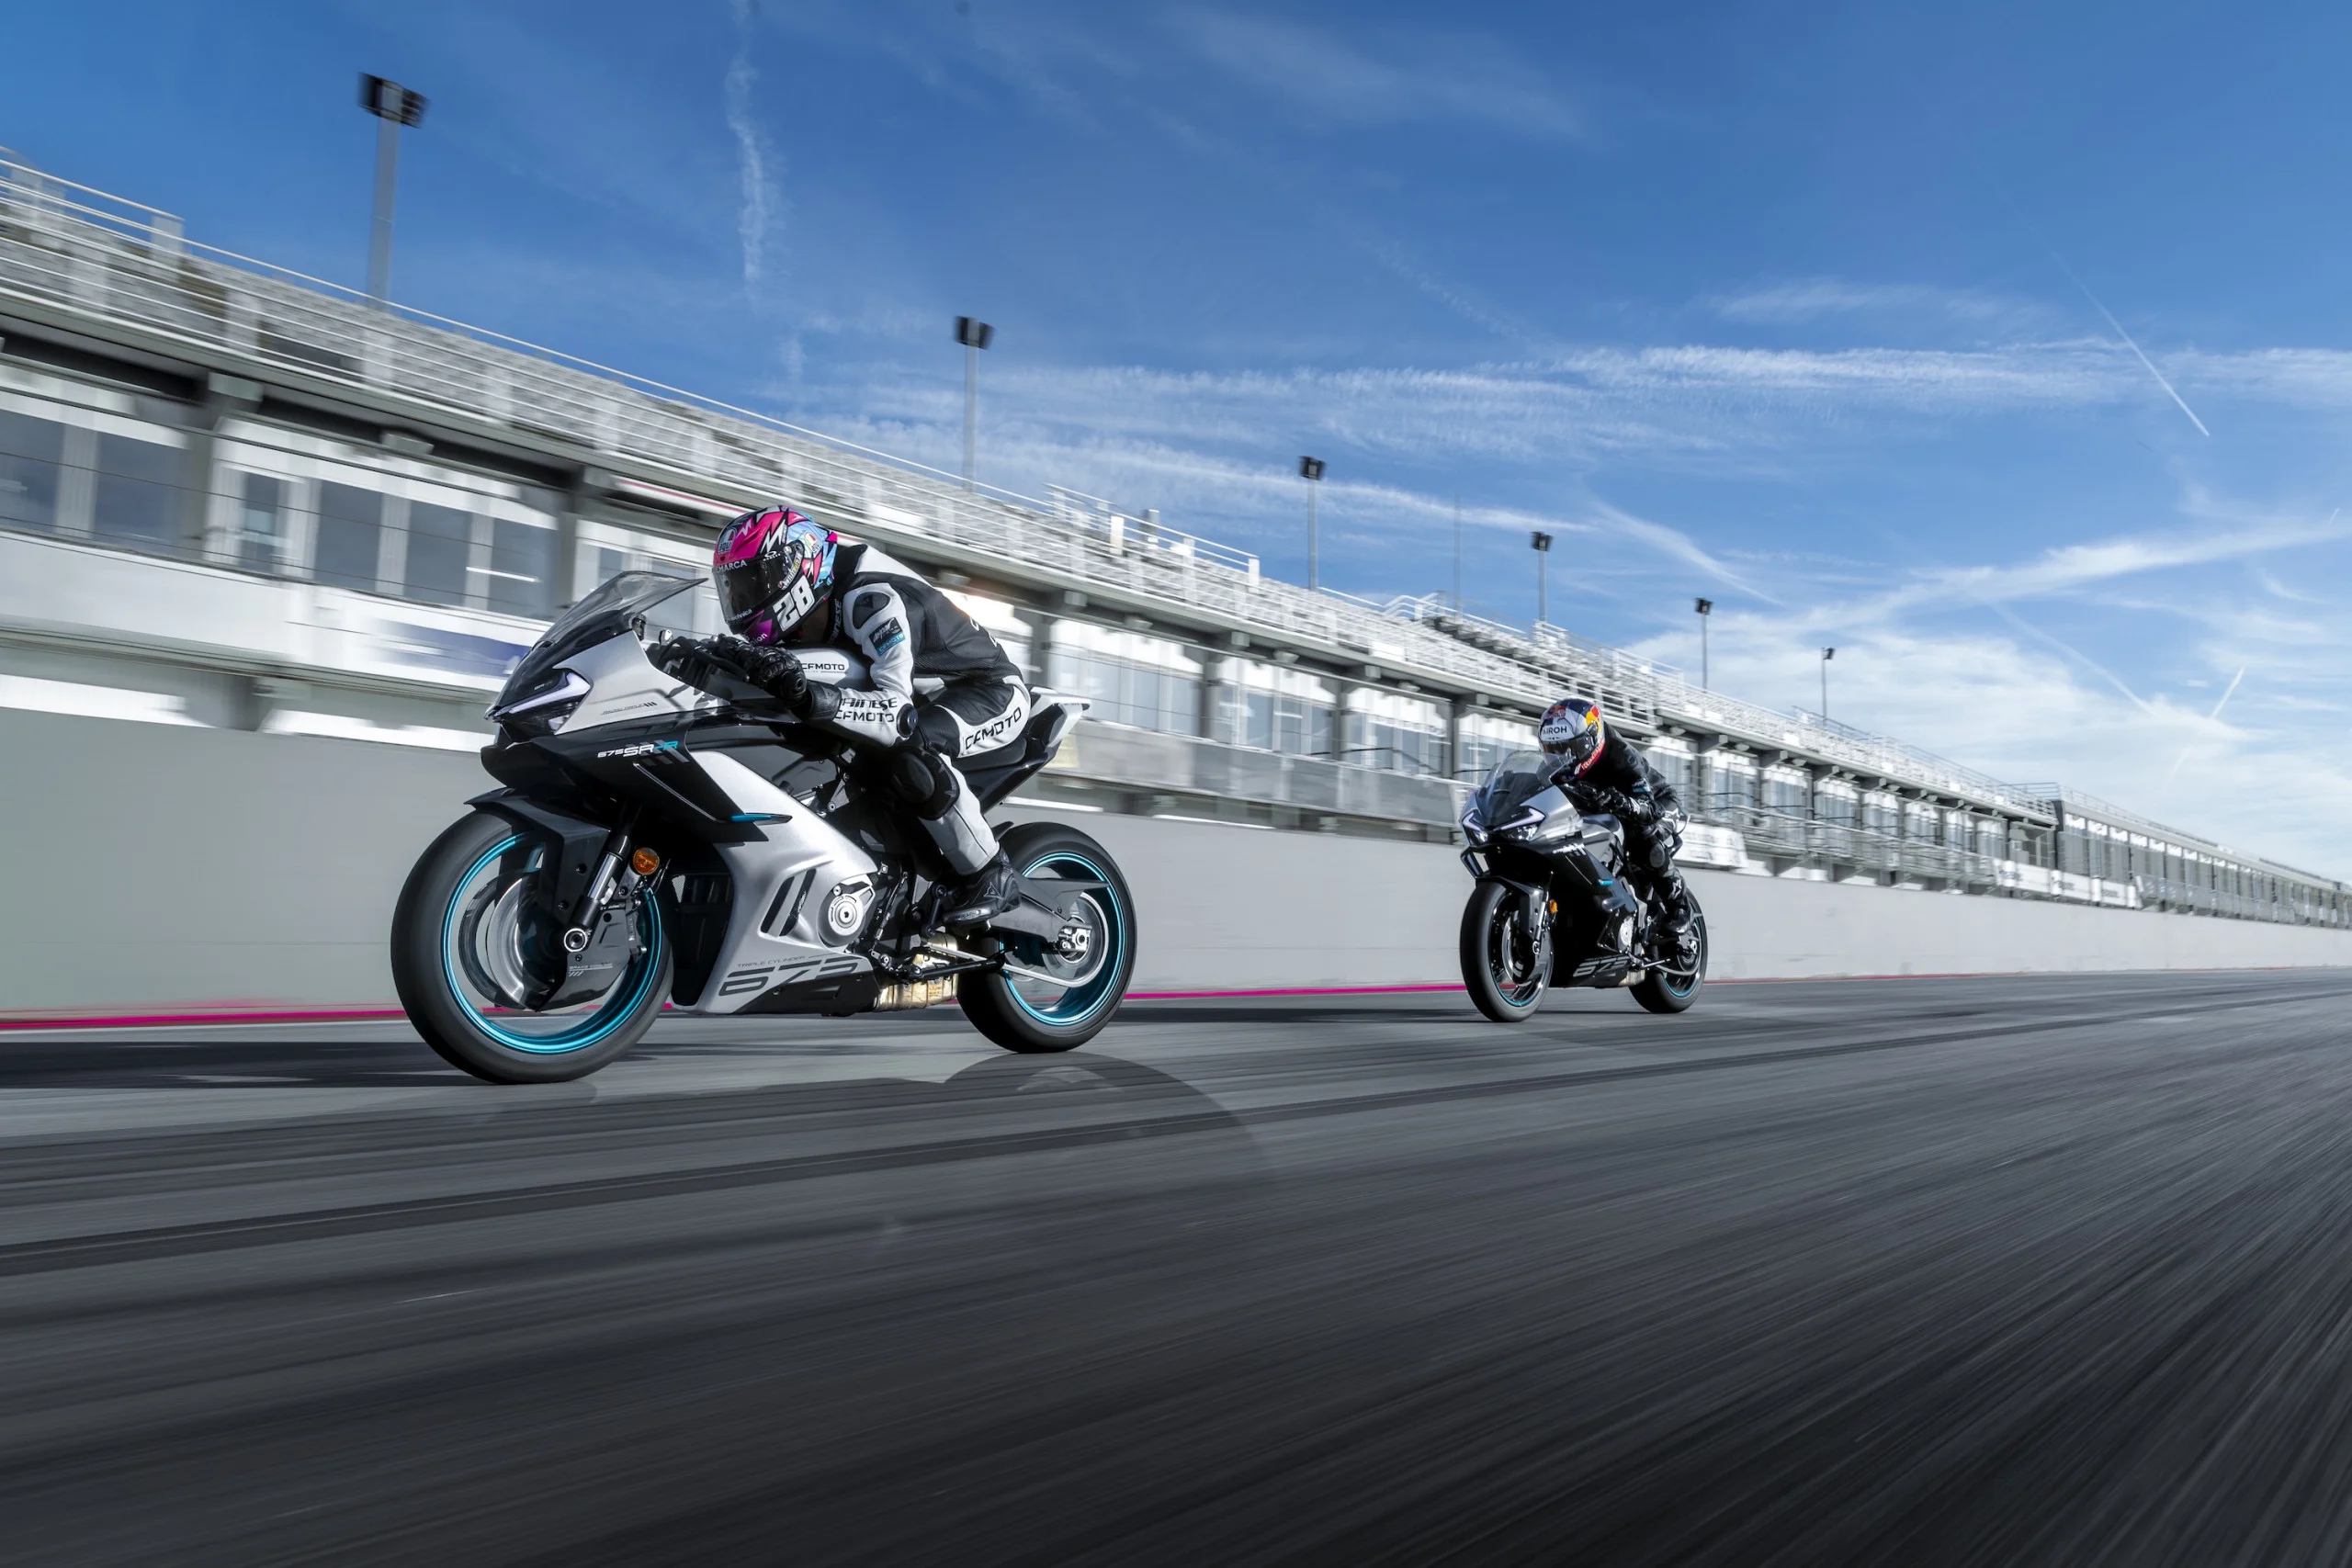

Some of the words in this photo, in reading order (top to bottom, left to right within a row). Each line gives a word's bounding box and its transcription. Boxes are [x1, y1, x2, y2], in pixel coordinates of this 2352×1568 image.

[773, 575, 815, 632] 28
[966, 706, 1022, 750] CFMOTO
[718, 956, 862, 997] 675
